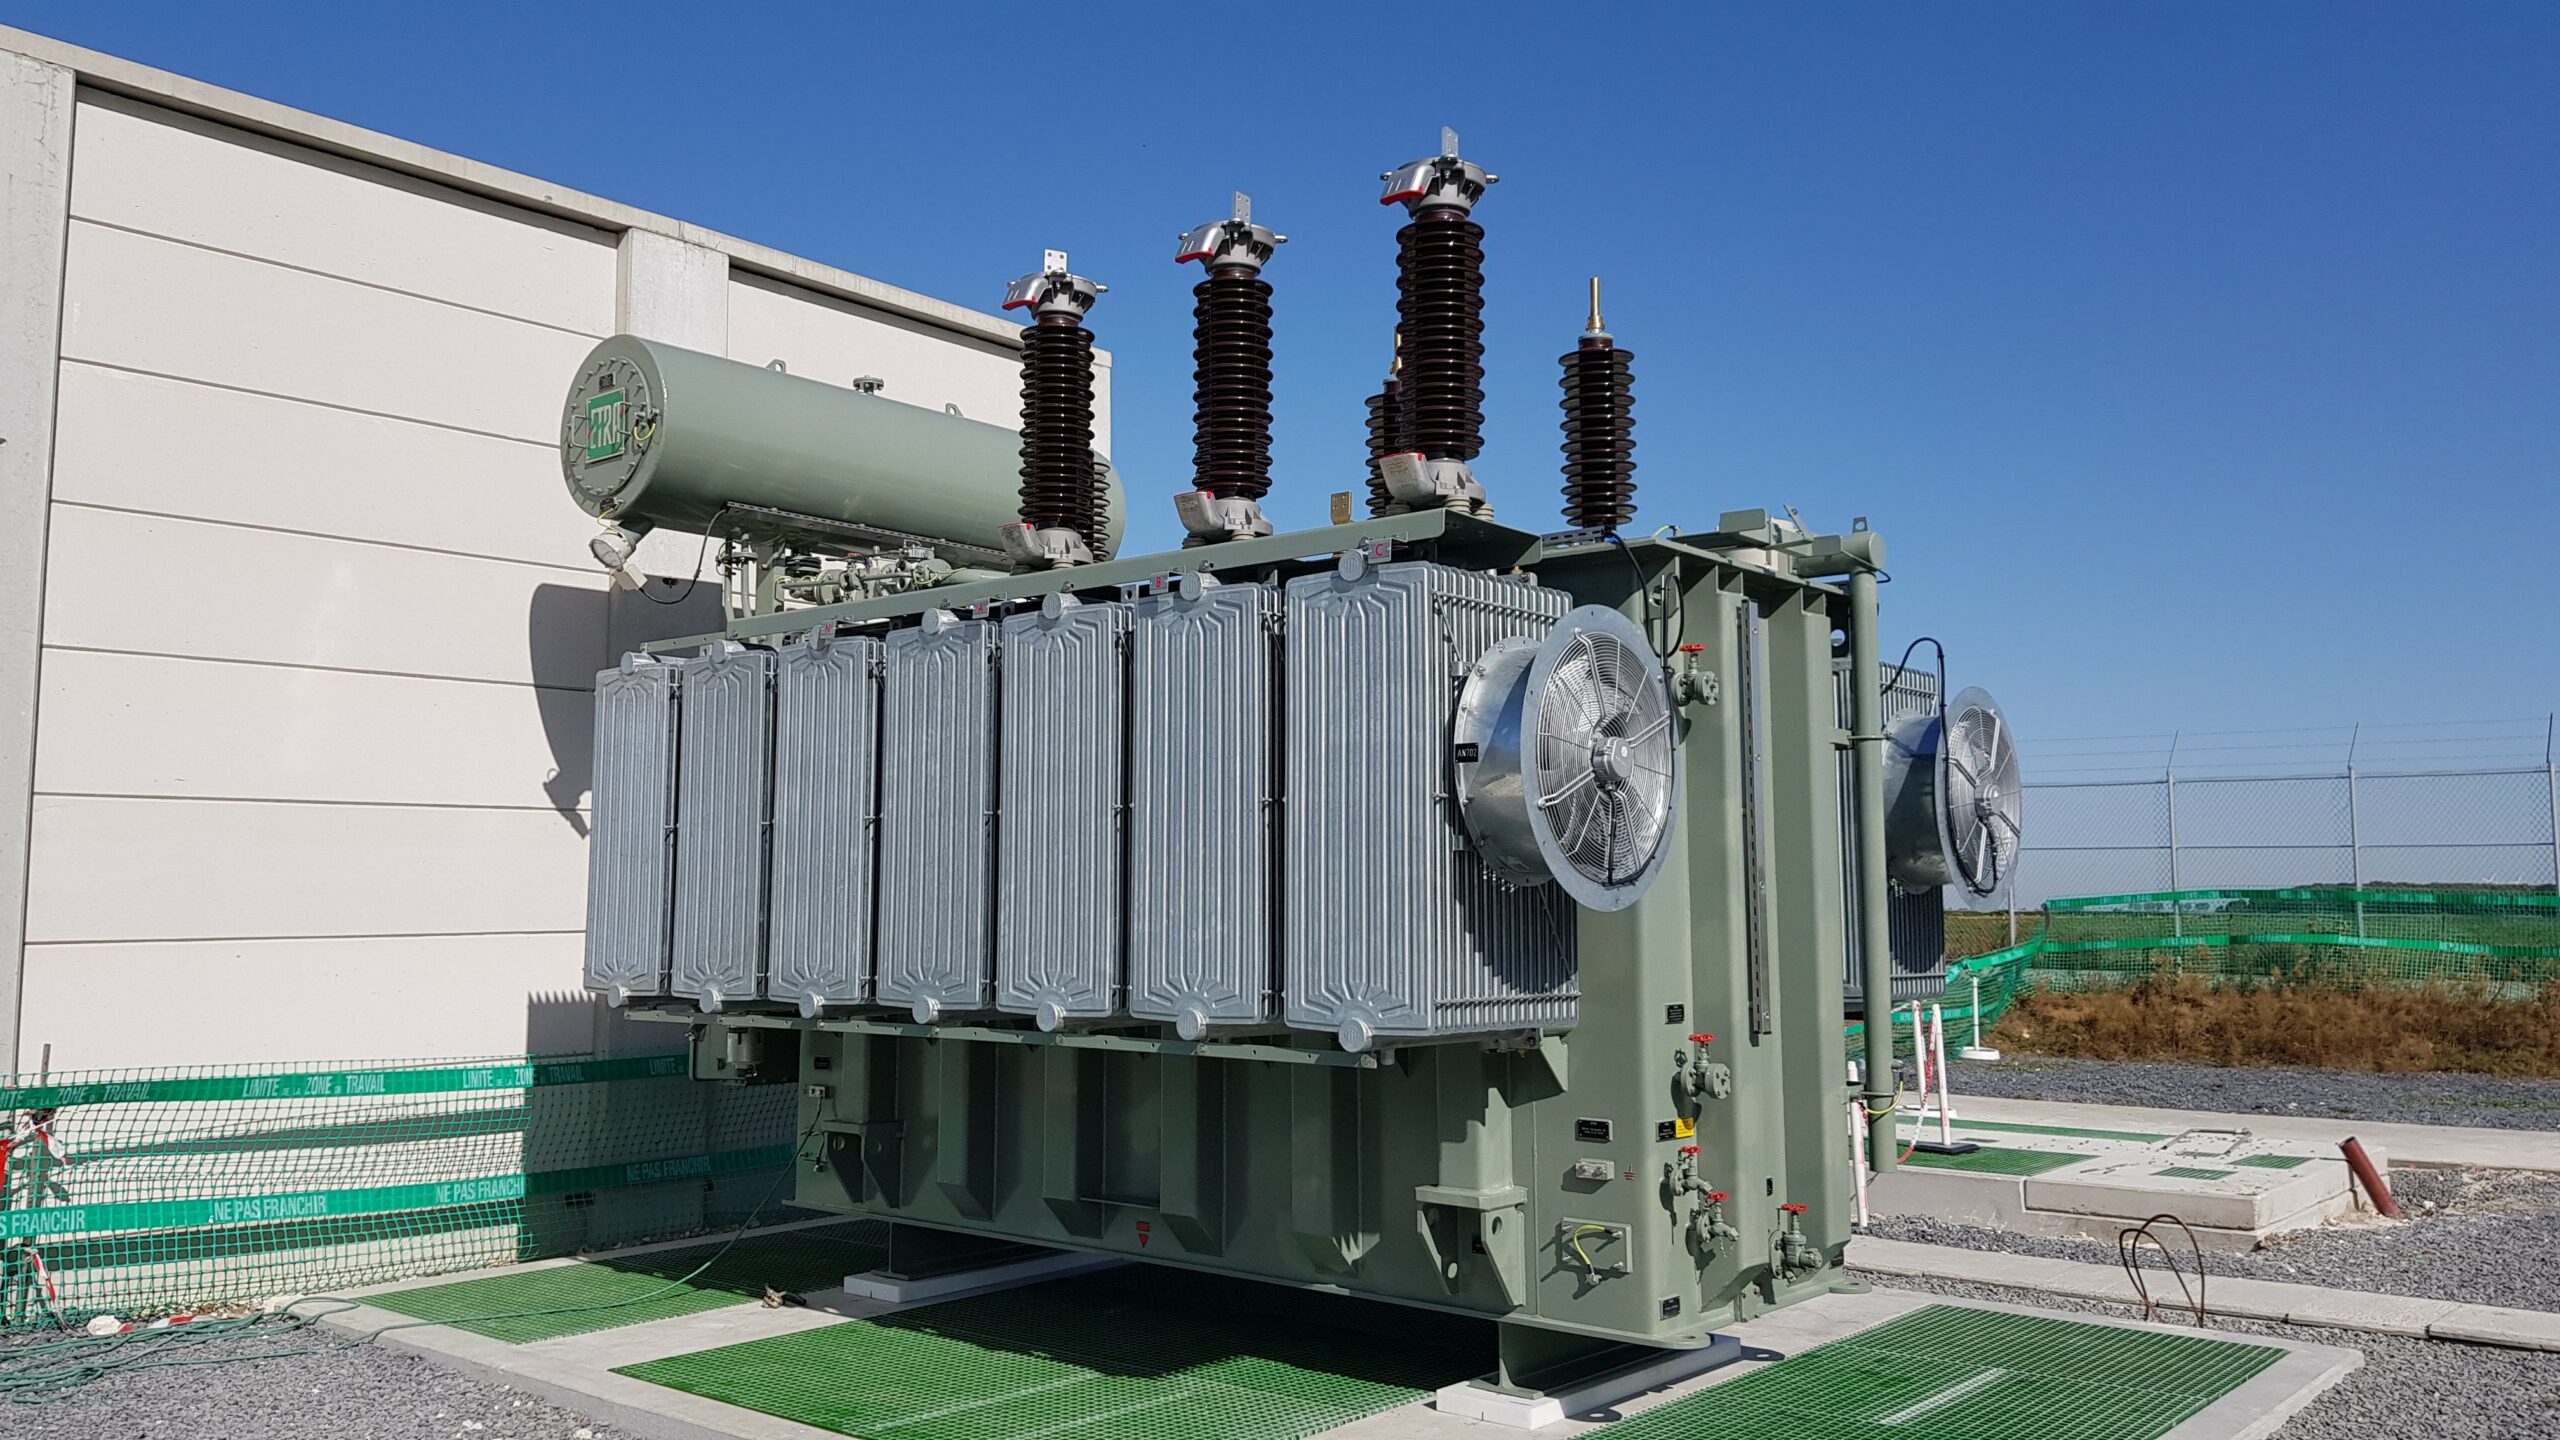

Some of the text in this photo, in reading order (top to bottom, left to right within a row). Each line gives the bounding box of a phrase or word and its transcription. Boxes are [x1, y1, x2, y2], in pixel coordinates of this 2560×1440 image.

[1375, 543, 1384, 558] C
[1154, 576, 1162, 588] B
[978, 602, 985, 613] A
[824, 624, 832, 634] N
[242, 1078, 280, 1098] LIMITE
[304, 1075, 333, 1095] ZONE
[345, 1073, 386, 1094] TRAVAIL
[463, 1069, 493, 1089] LIMITE
[55, 1086, 89, 1104] ZONE
[102, 1083, 151, 1101] TRAVAIL
[436, 1185, 451, 1203] NE
[453, 1182, 476, 1201] PAS
[214, 1194, 327, 1221] NE PAS FRANCHIR
[11, 1209, 86, 1235] FRANCHIR
